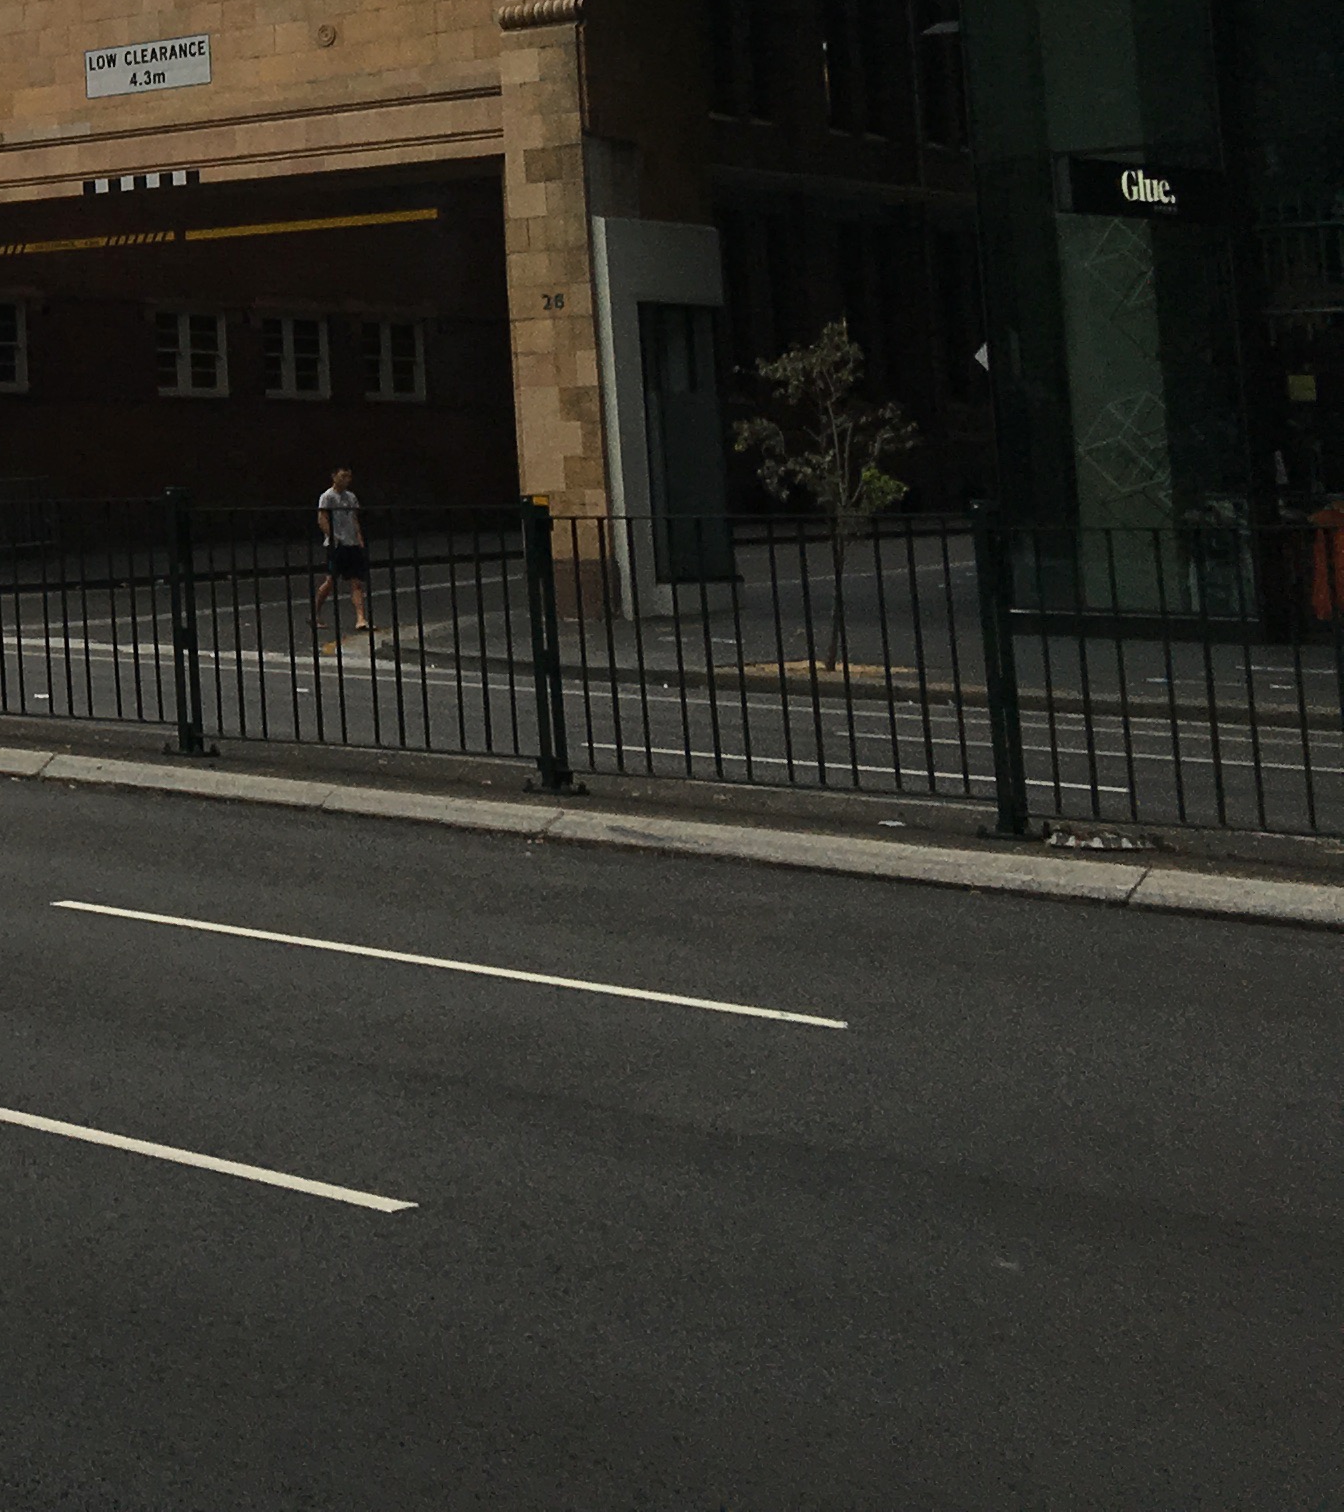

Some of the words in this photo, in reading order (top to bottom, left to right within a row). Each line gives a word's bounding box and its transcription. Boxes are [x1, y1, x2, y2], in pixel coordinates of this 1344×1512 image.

[89, 53, 117, 70] LOW
[124, 41, 206, 65] CLEARANCE
[130, 70, 165, 86] 4.3m
